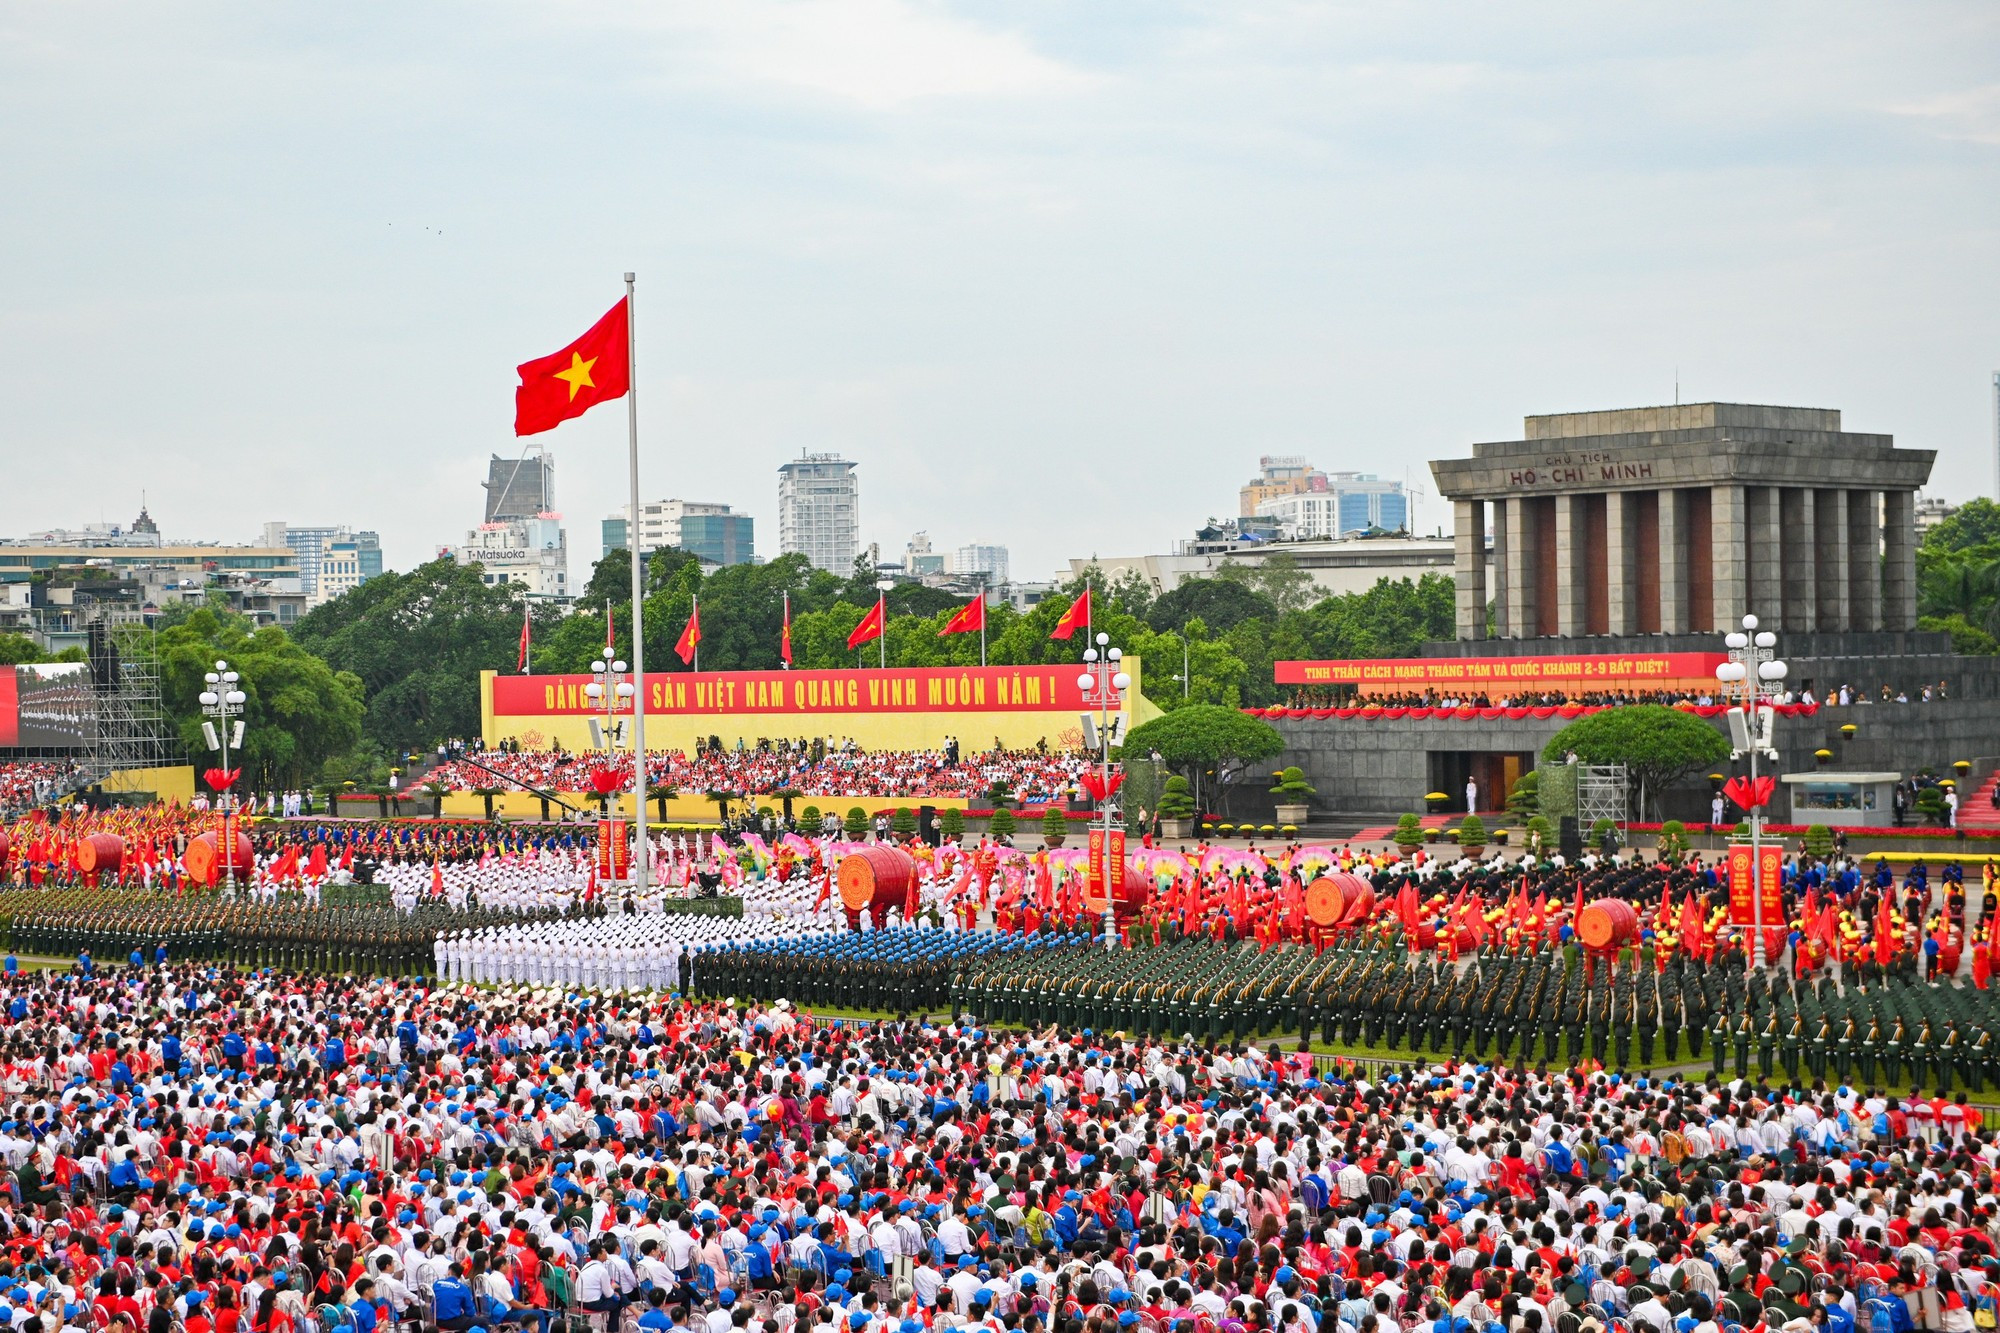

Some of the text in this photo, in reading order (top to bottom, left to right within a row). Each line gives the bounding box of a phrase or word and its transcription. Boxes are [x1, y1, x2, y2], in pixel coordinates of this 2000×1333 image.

[1304, 667, 1330, 679] TINH
[1363, 664, 1391, 678] CÁCH
[1394, 665, 1424, 680] MẠNG
[1427, 663, 1463, 677] THÁNG
[1466, 662, 1490, 677] TÁM
[1493, 661, 1508, 676] VÀ
[1510, 660, 1539, 676] QUỐC
[1542, 659, 1581, 675] KHÁNH
[1584, 662, 1606, 675] 2-9
[1609, 658, 1633, 674] BẤT
[545, 679, 589, 710] ĐẢNG
[652, 676, 686, 709] SẢN
[695, 677, 735, 713] VIỆT
[745, 680, 784, 708] NAM
[794, 679, 858, 710] QUANG
[868, 678, 917, 706] VINH
[928, 672, 985, 706] MUÔN
